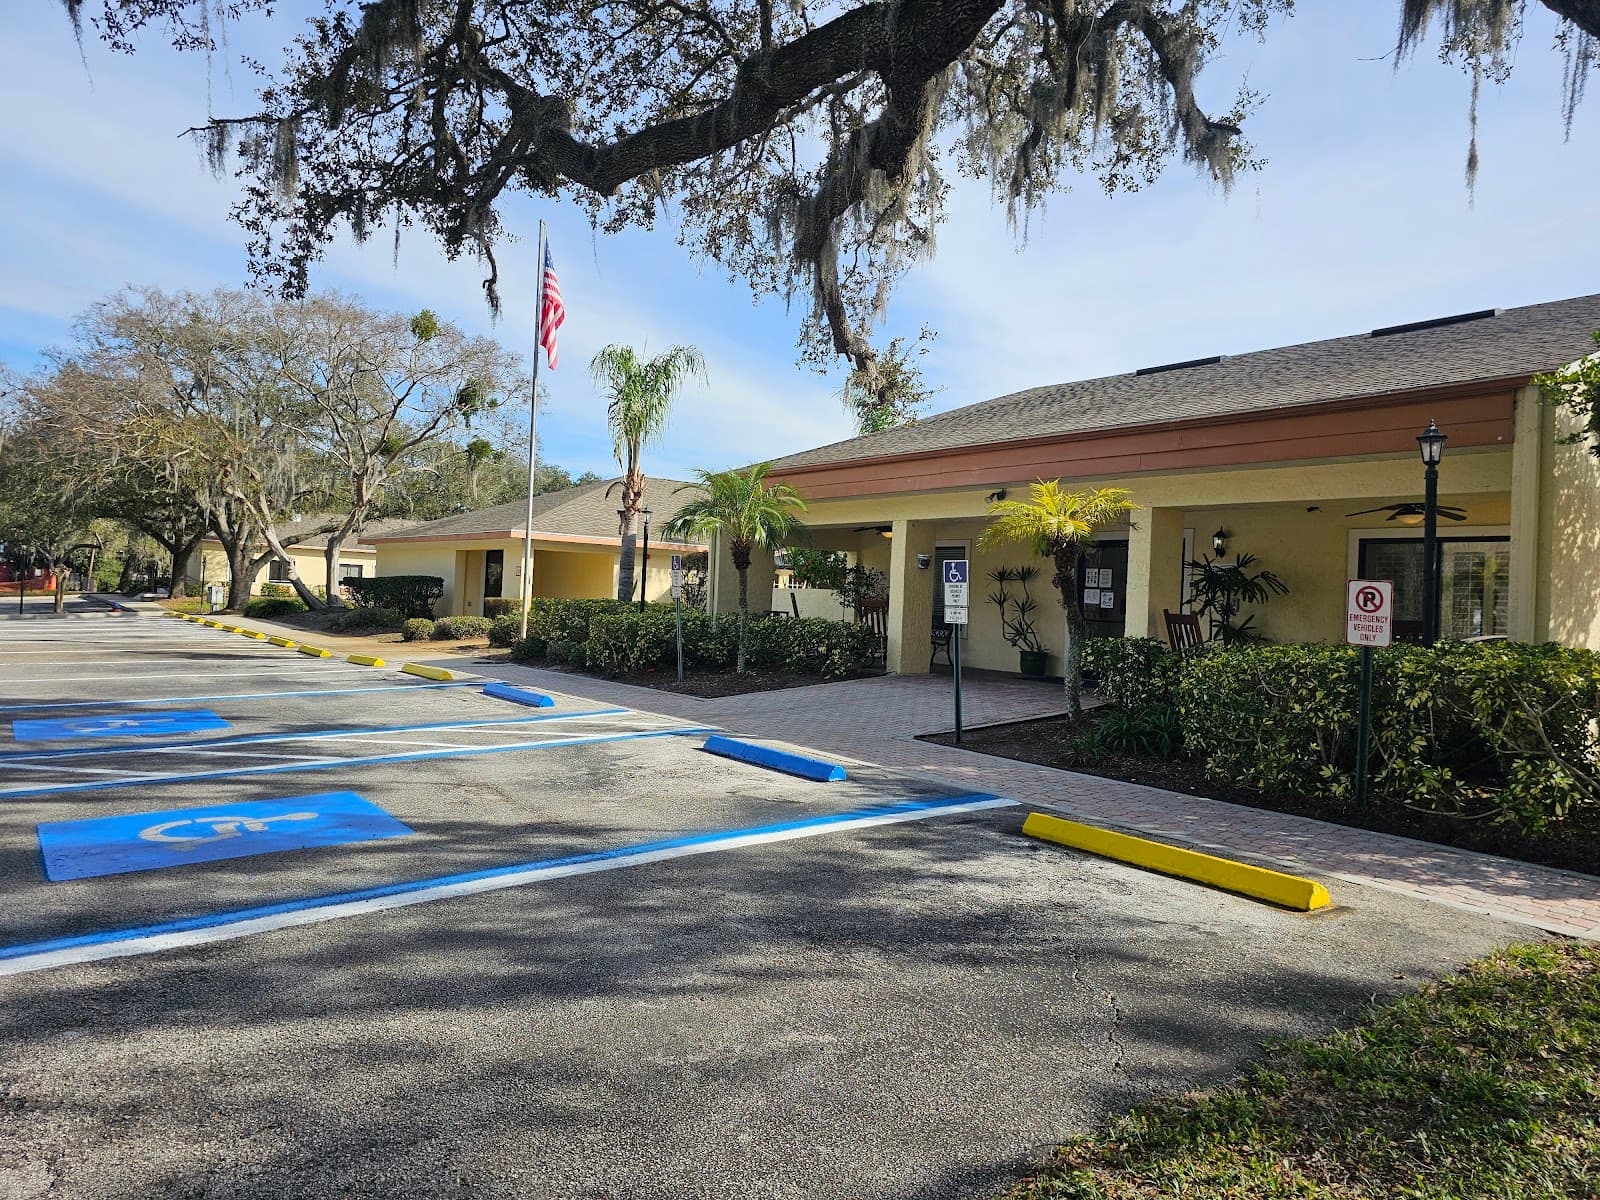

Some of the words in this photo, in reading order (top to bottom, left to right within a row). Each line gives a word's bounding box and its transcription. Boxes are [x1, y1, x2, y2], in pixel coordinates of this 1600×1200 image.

[1349, 614, 1389, 624] EMERGENCY
[1353, 624, 1384, 633] VEHICLES
[1360, 634, 1377, 642] ONLY
